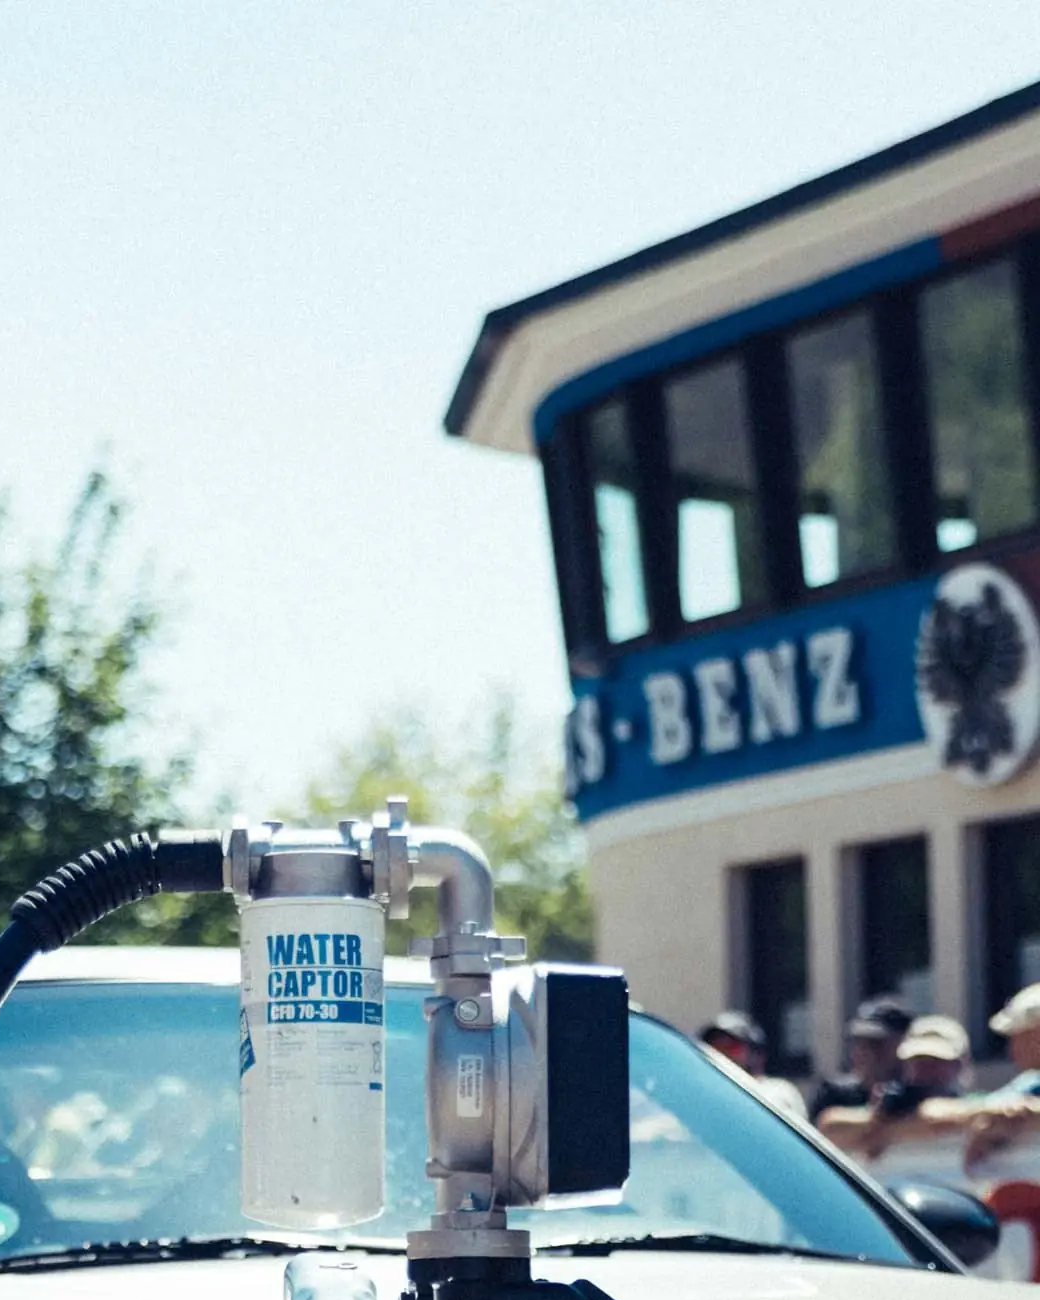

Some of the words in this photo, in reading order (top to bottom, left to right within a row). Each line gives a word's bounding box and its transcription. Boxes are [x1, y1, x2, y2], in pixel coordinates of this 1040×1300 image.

[266, 934, 362, 966] WATER
[268, 970, 363, 998] CAPTOR
[298, 1003, 339, 1020] 70-30
